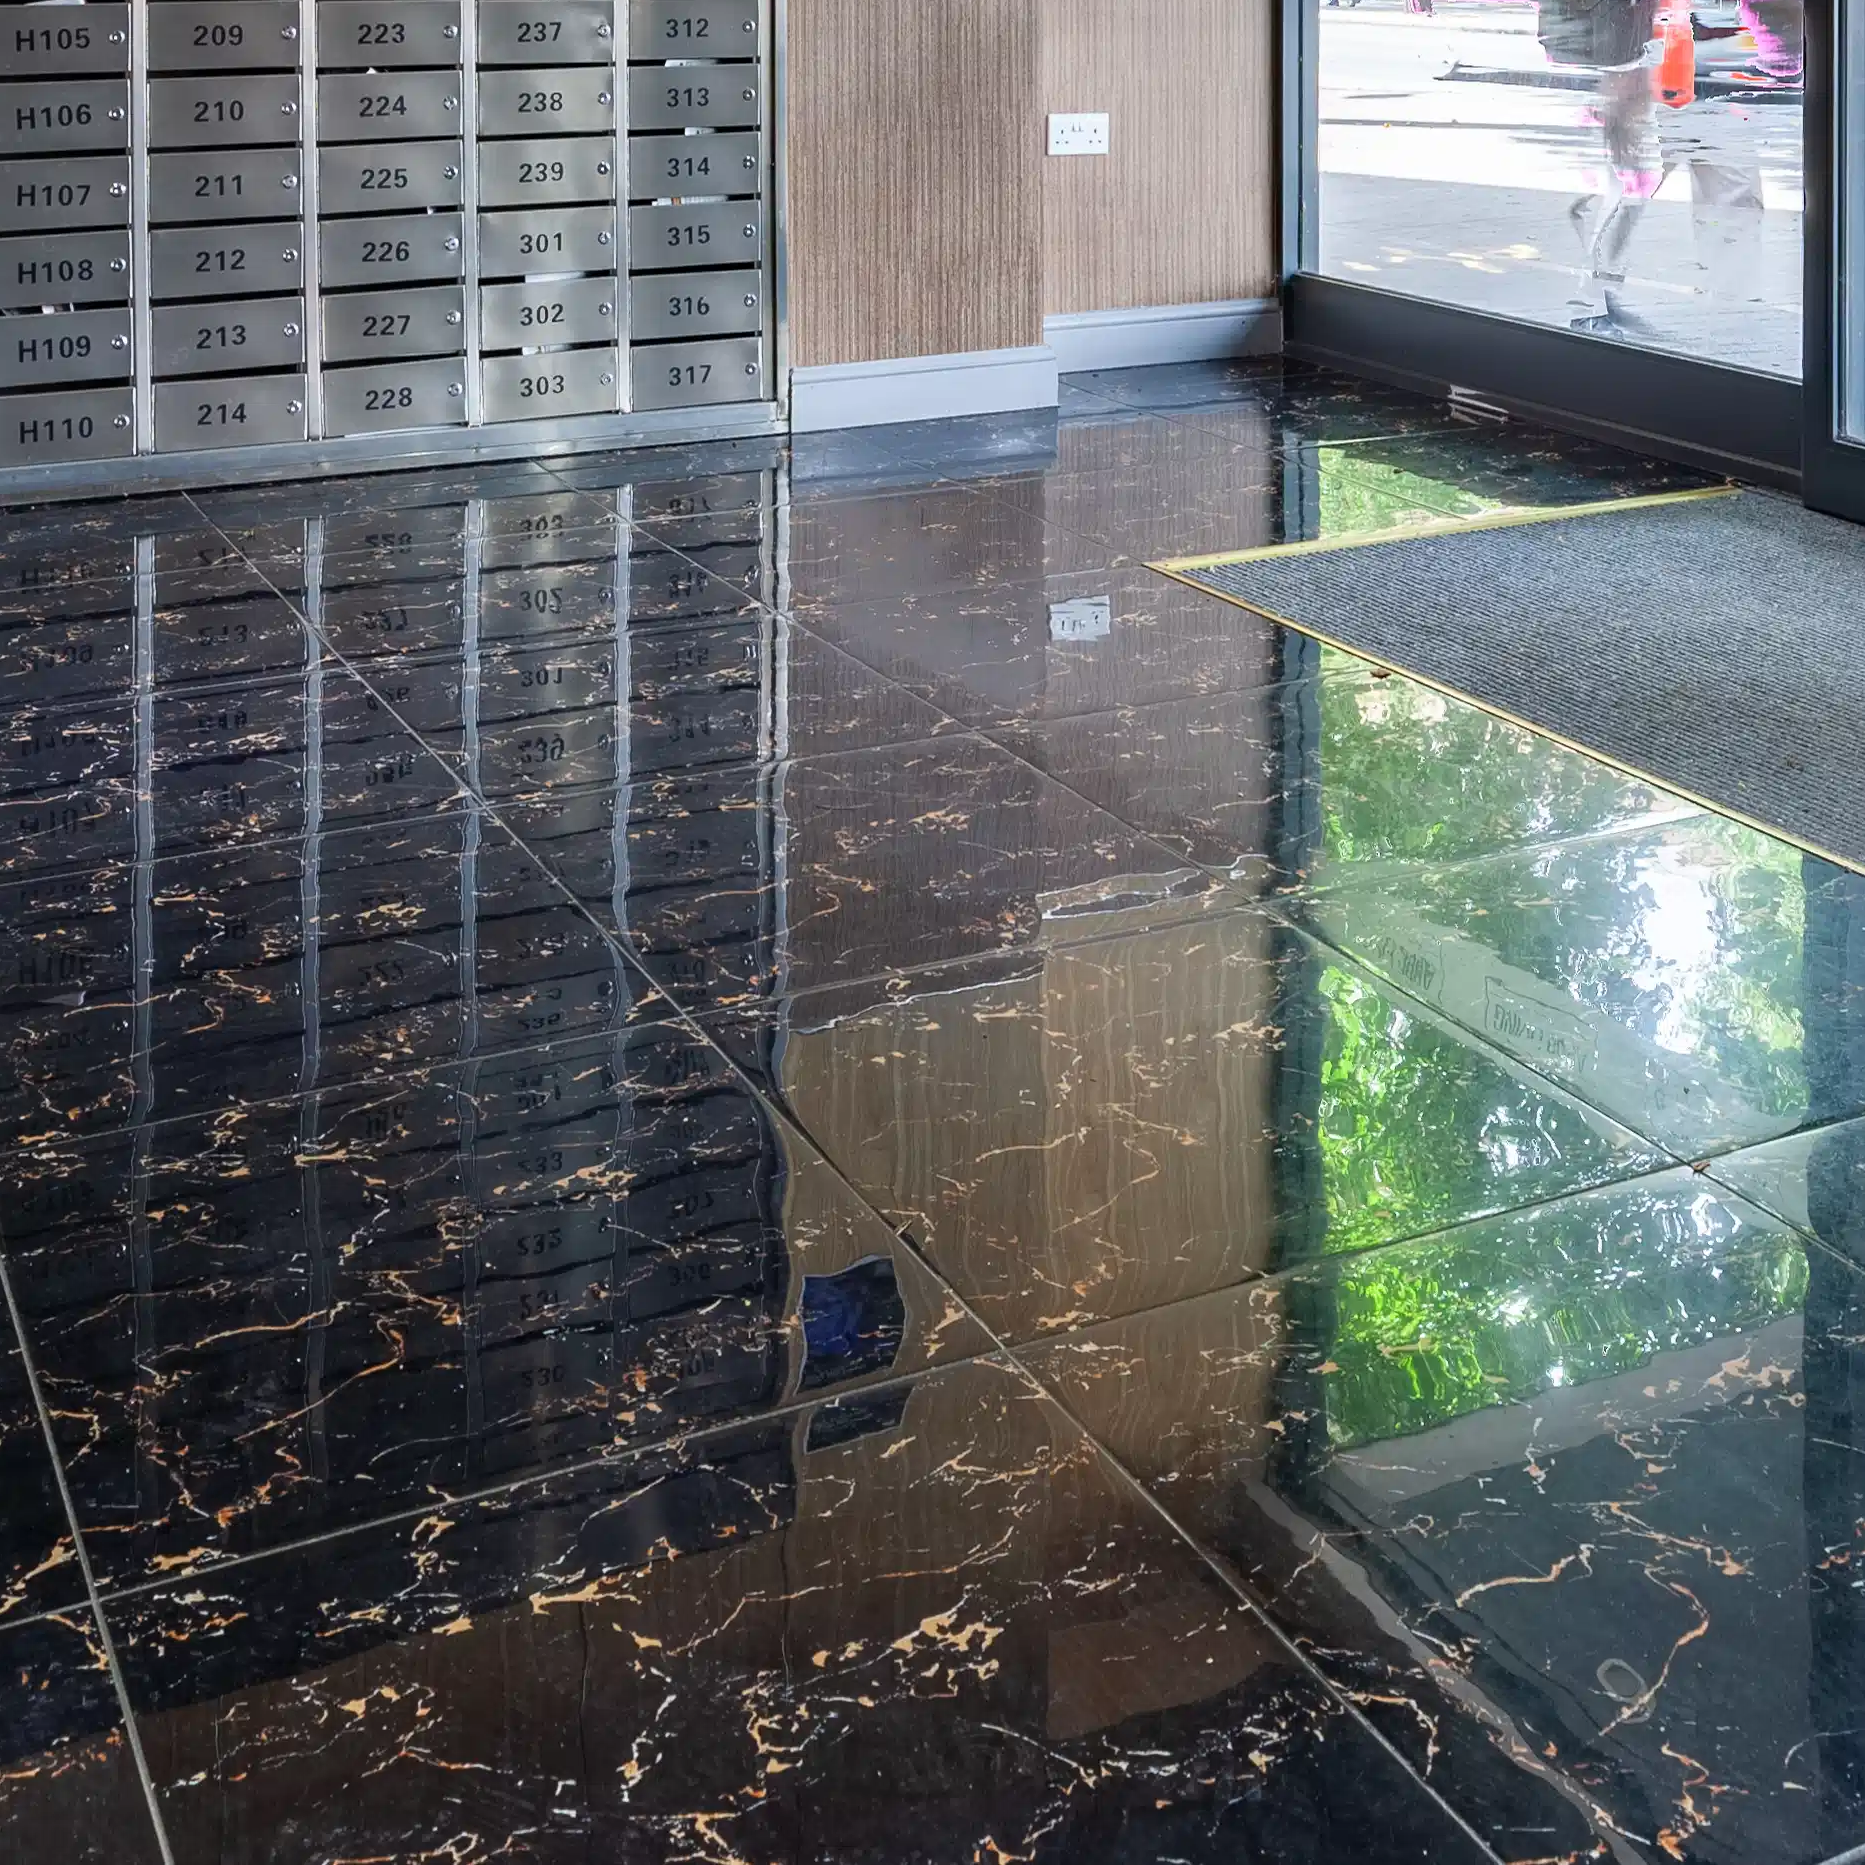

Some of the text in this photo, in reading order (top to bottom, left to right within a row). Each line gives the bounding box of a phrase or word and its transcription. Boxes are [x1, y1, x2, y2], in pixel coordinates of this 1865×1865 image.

[15, 27, 91, 52] H105
[193, 25, 244, 47] 209
[357, 22, 406, 45] 223
[517, 21, 562, 43] 237
[665, 18, 709, 39] 312
[358, 94, 408, 118] 224
[517, 92, 563, 113] 238
[666, 86, 710, 108] 313
[16, 103, 92, 131] H106
[193, 100, 244, 123] 210
[518, 161, 564, 184] 239
[666, 156, 711, 178] 314
[194, 174, 242, 198] 211
[360, 168, 408, 190] 225
[16, 184, 91, 207] H107
[519, 232, 562, 255] 301
[666, 224, 711, 247] 315
[195, 248, 246, 273] 212
[361, 240, 410, 263] 226
[17, 258, 94, 285] H108
[517, 302, 565, 327] 302
[668, 296, 710, 317] 316
[196, 324, 247, 350] 213
[362, 314, 411, 337] 227
[18, 335, 91, 364] H109
[519, 374, 565, 399] 303
[668, 364, 712, 387] 317
[364, 386, 413, 411] 228
[196, 402, 248, 427] 214
[19, 416, 94, 445] H110
